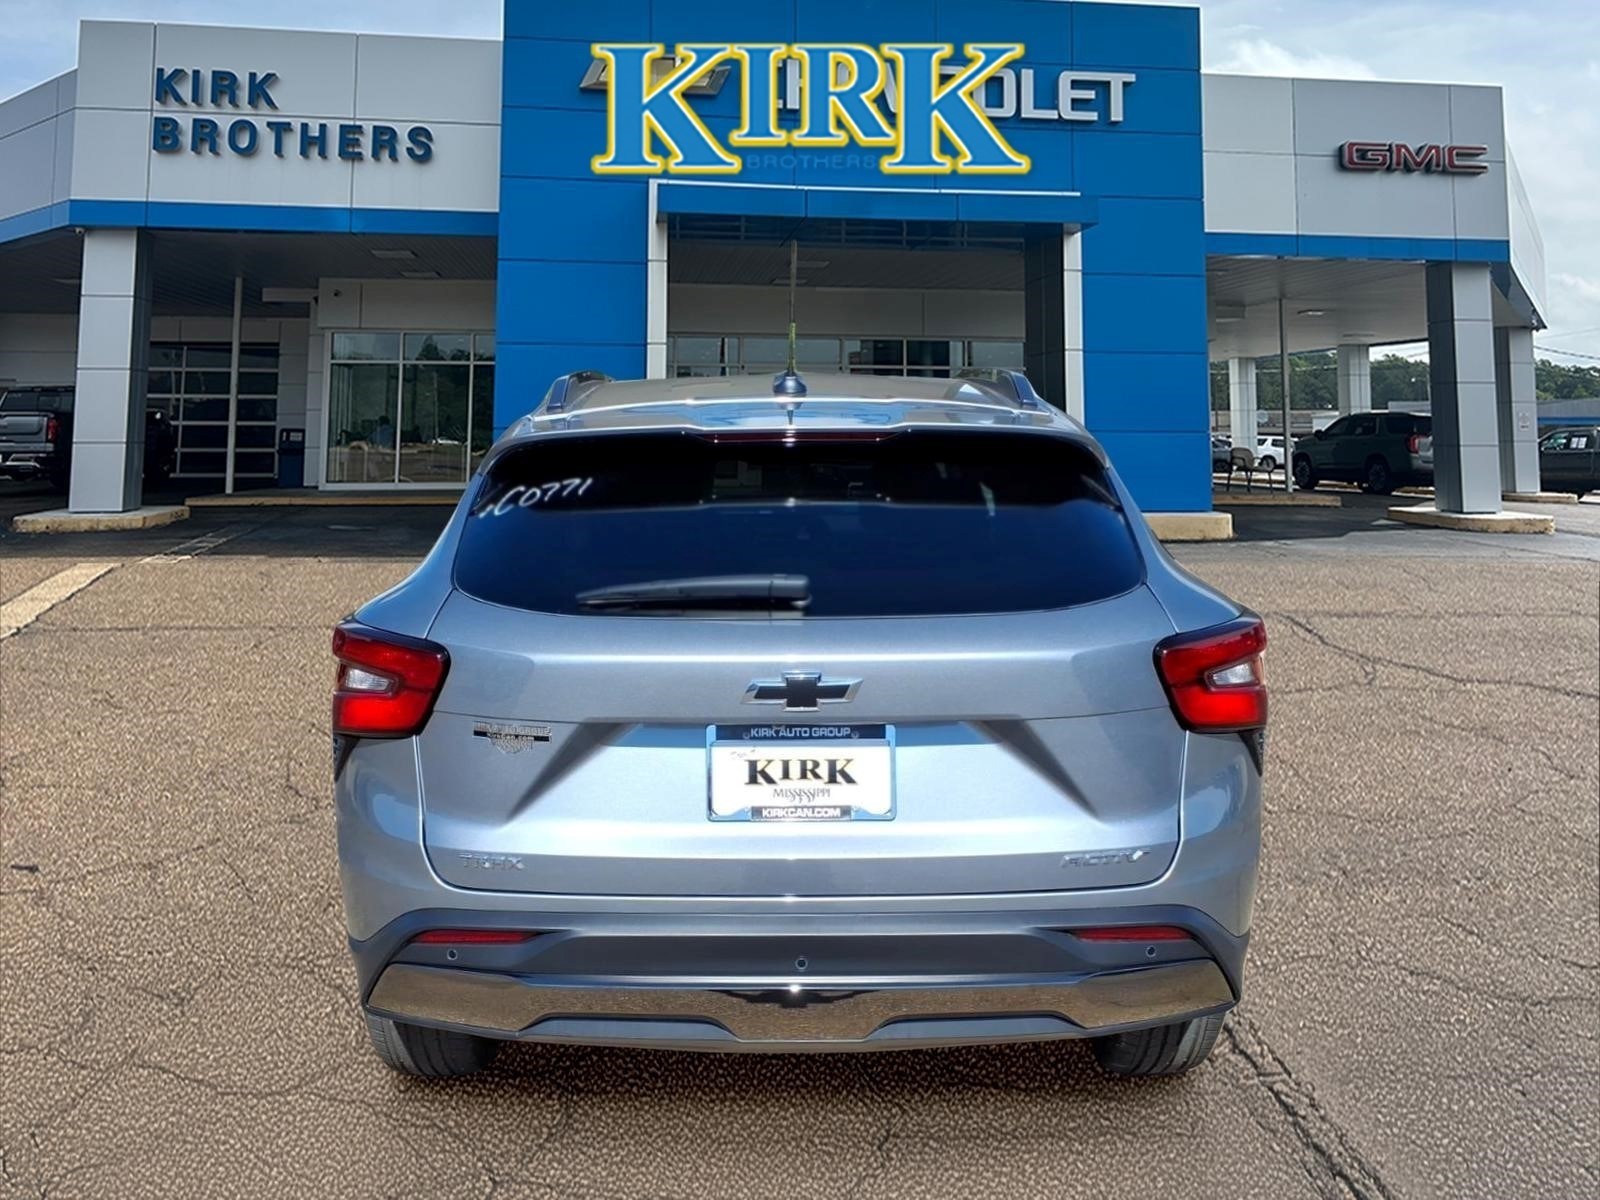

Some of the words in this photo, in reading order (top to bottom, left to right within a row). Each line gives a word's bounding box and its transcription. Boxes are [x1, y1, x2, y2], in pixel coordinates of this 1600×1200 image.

[154, 67, 280, 110] KIRK
[152, 116, 434, 164] BROTHERS
[1340, 140, 1489, 176] GMC
[750, 727, 775, 738] KIRK
[780, 727, 809, 738] AUTO
[811, 727, 850, 737] GROUP
[744, 758, 858, 785] KIRK
